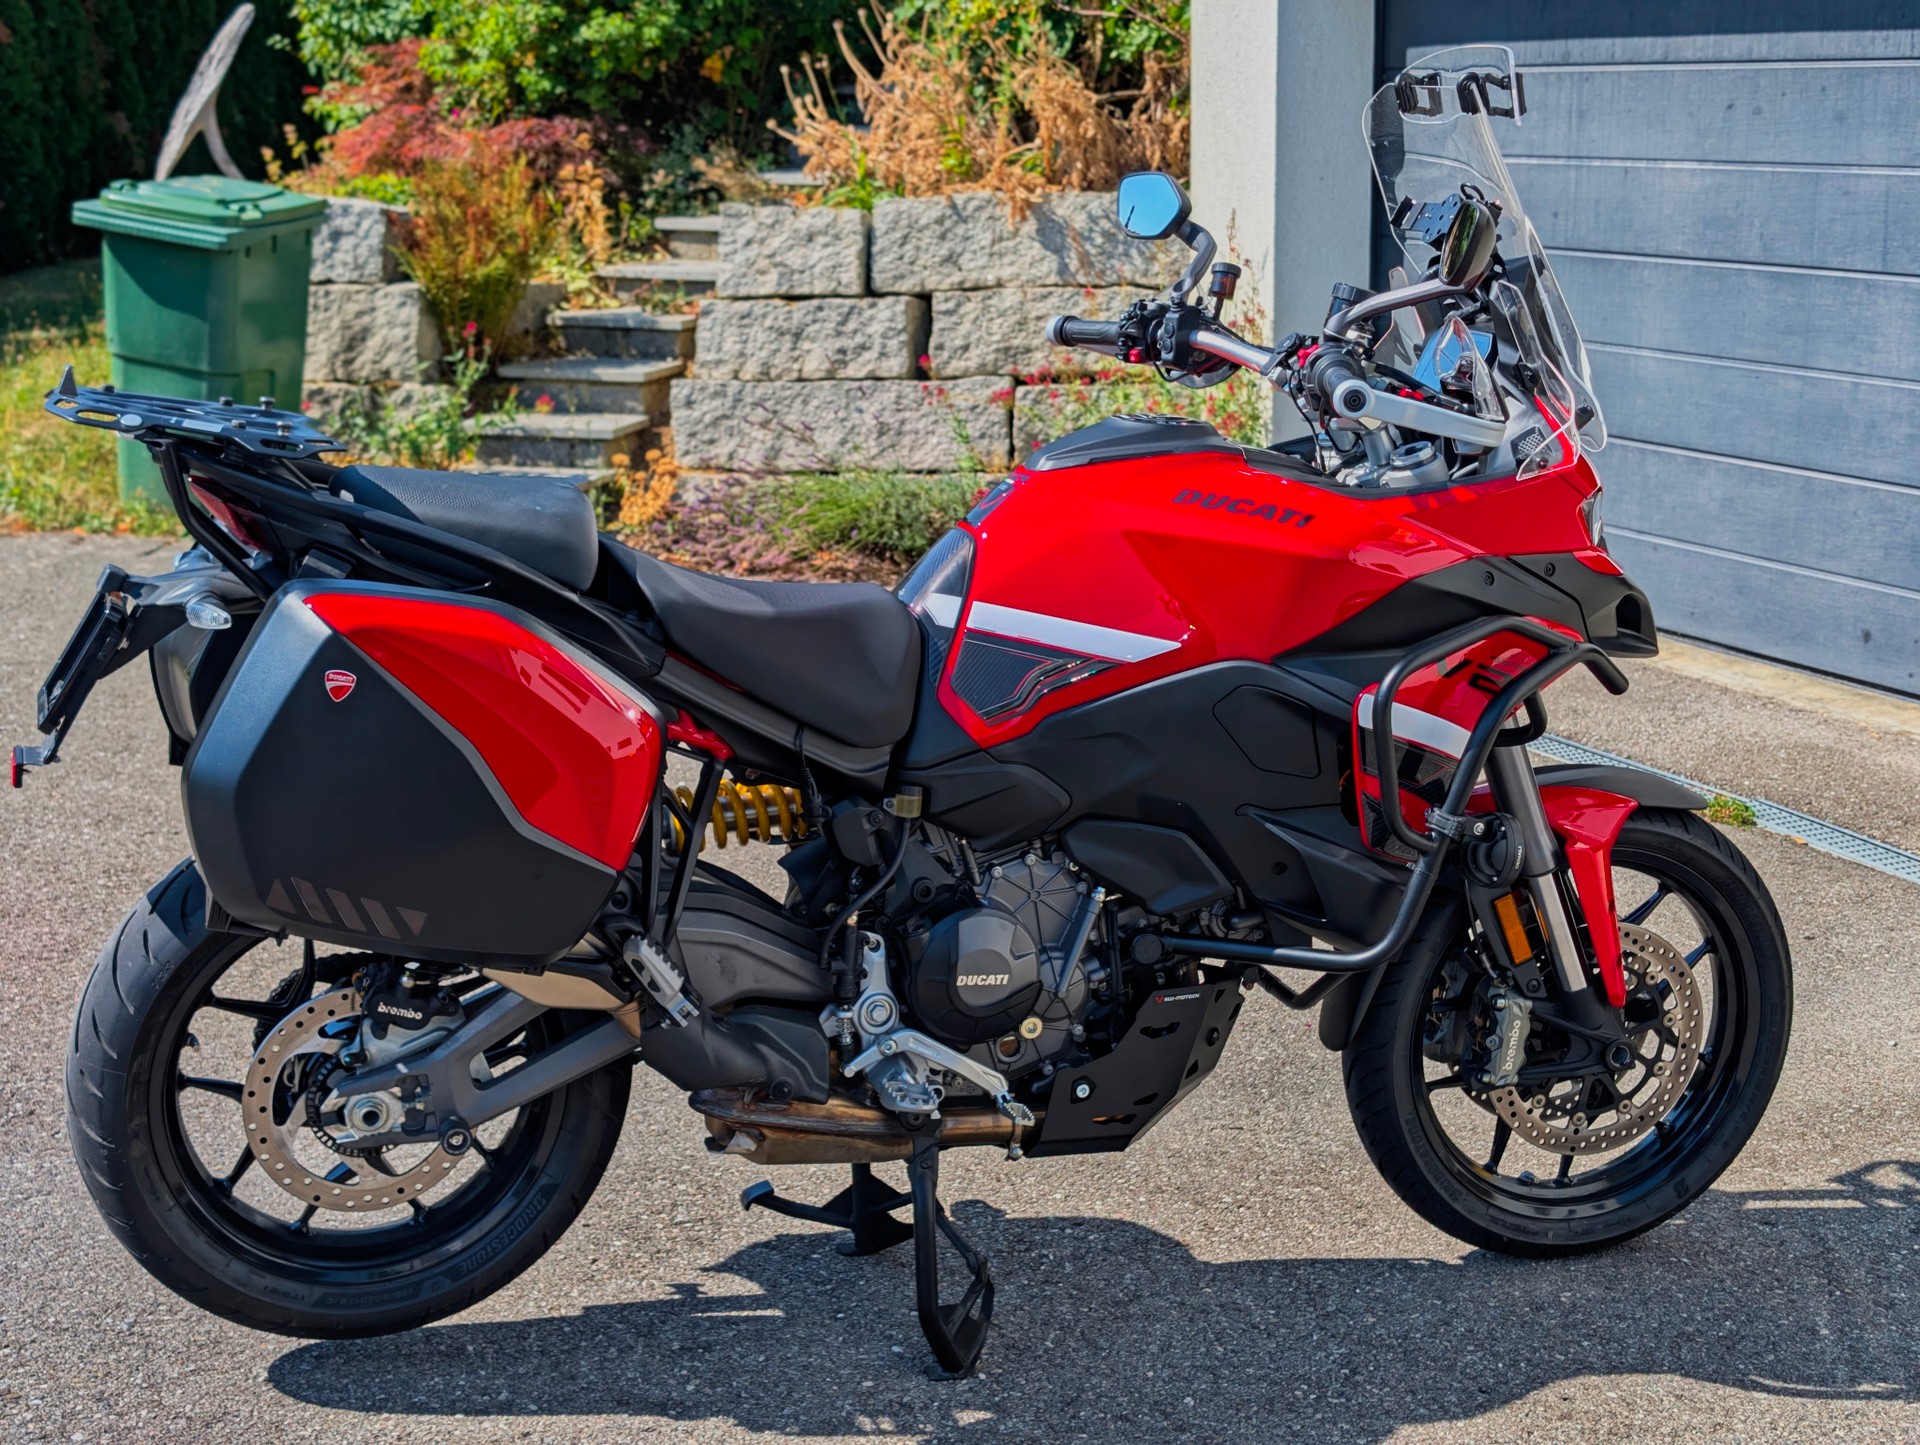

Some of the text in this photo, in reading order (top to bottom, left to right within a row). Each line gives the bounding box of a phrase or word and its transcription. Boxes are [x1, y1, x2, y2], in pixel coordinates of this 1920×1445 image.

[1172, 488, 1316, 528] DUCATI
[956, 974, 1009, 986] DUCATI
[377, 1001, 423, 1020] brembo
[1502, 1020, 1521, 1071] brembo
[459, 1188, 548, 1275] BRIDGESTONE
